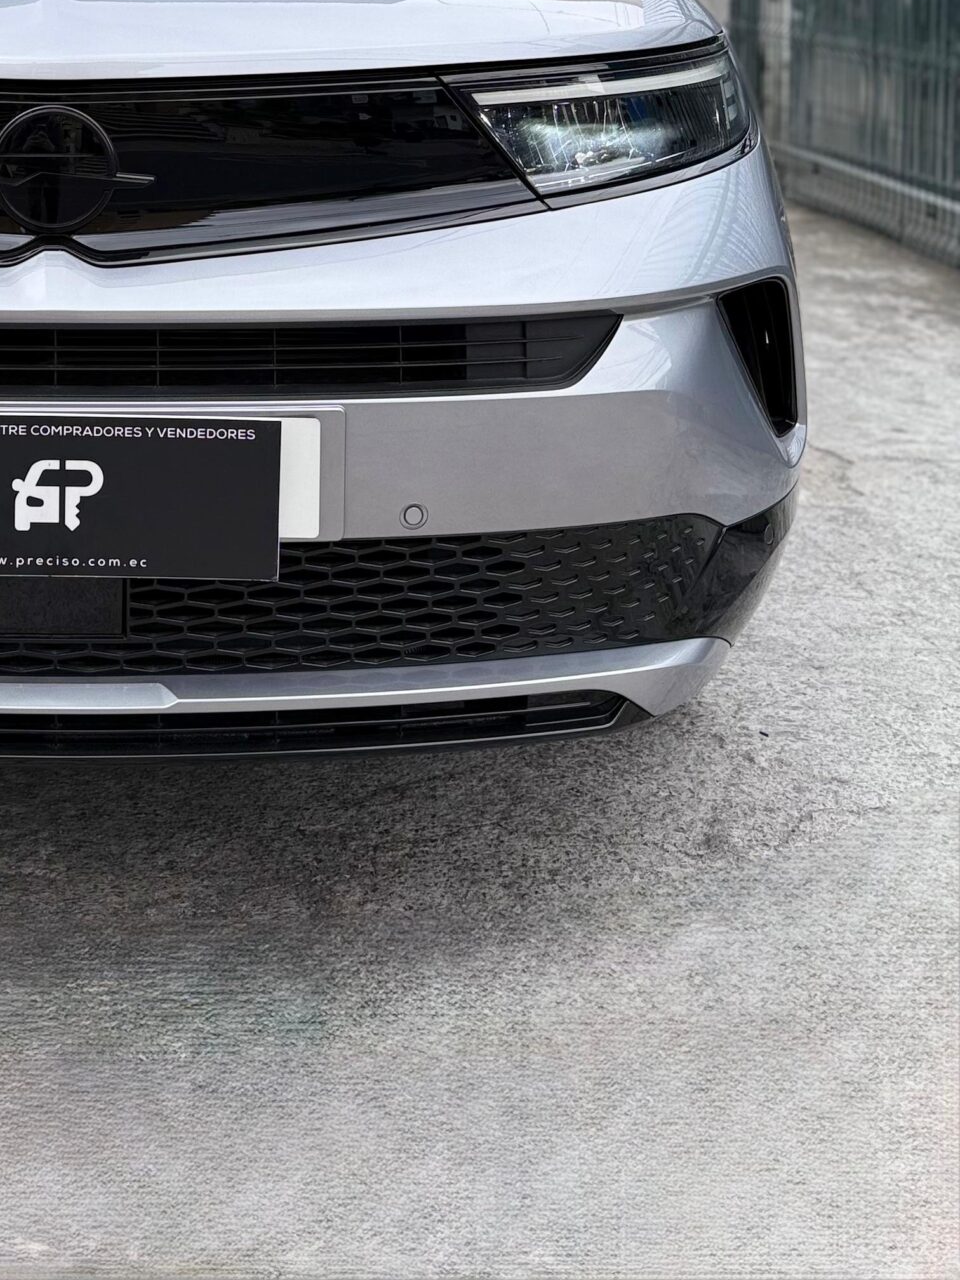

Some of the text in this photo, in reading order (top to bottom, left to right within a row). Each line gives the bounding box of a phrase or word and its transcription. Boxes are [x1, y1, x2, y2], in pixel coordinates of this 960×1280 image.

[30, 425, 142, 438] COMPRADORES
[145, 427, 155, 438] Y
[157, 427, 256, 440] VENDEDORES
